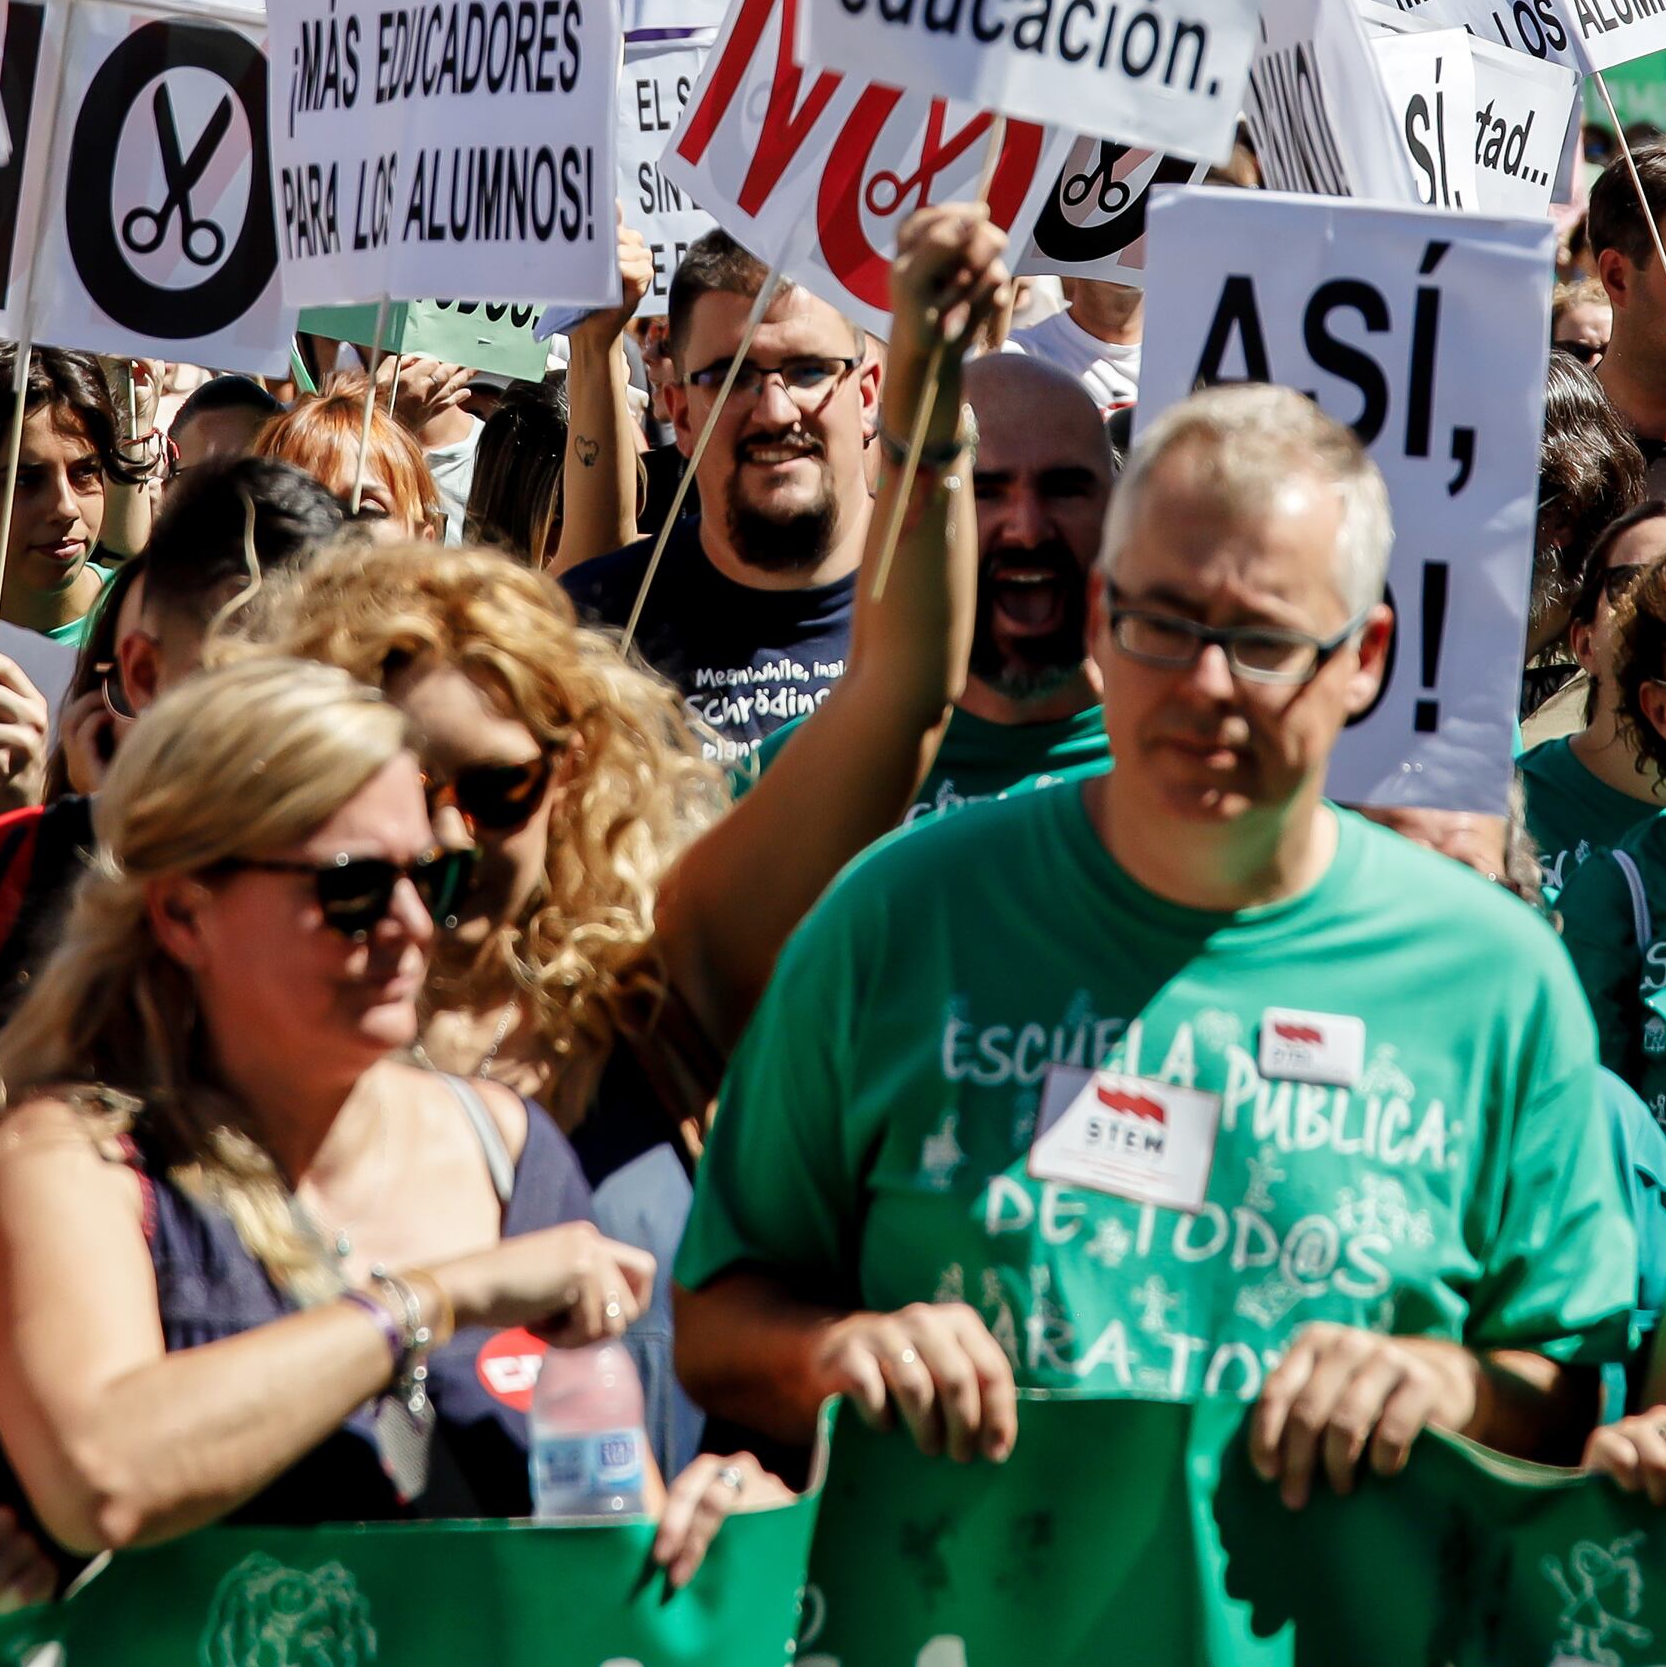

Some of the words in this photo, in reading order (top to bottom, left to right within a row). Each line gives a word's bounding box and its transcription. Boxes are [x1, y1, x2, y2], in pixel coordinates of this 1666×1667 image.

[635, 78, 671, 132] EL
[281, 163, 335, 263] PARA
[353, 150, 399, 252] LOS
[402, 144, 596, 243] ALUMNOS!
[637, 159, 683, 215] SIN
[1189, 240, 1477, 498] ASÍ,
[943, 1017, 1198, 1086] ESCUELA
[985, 1176, 1086, 1244] DE
